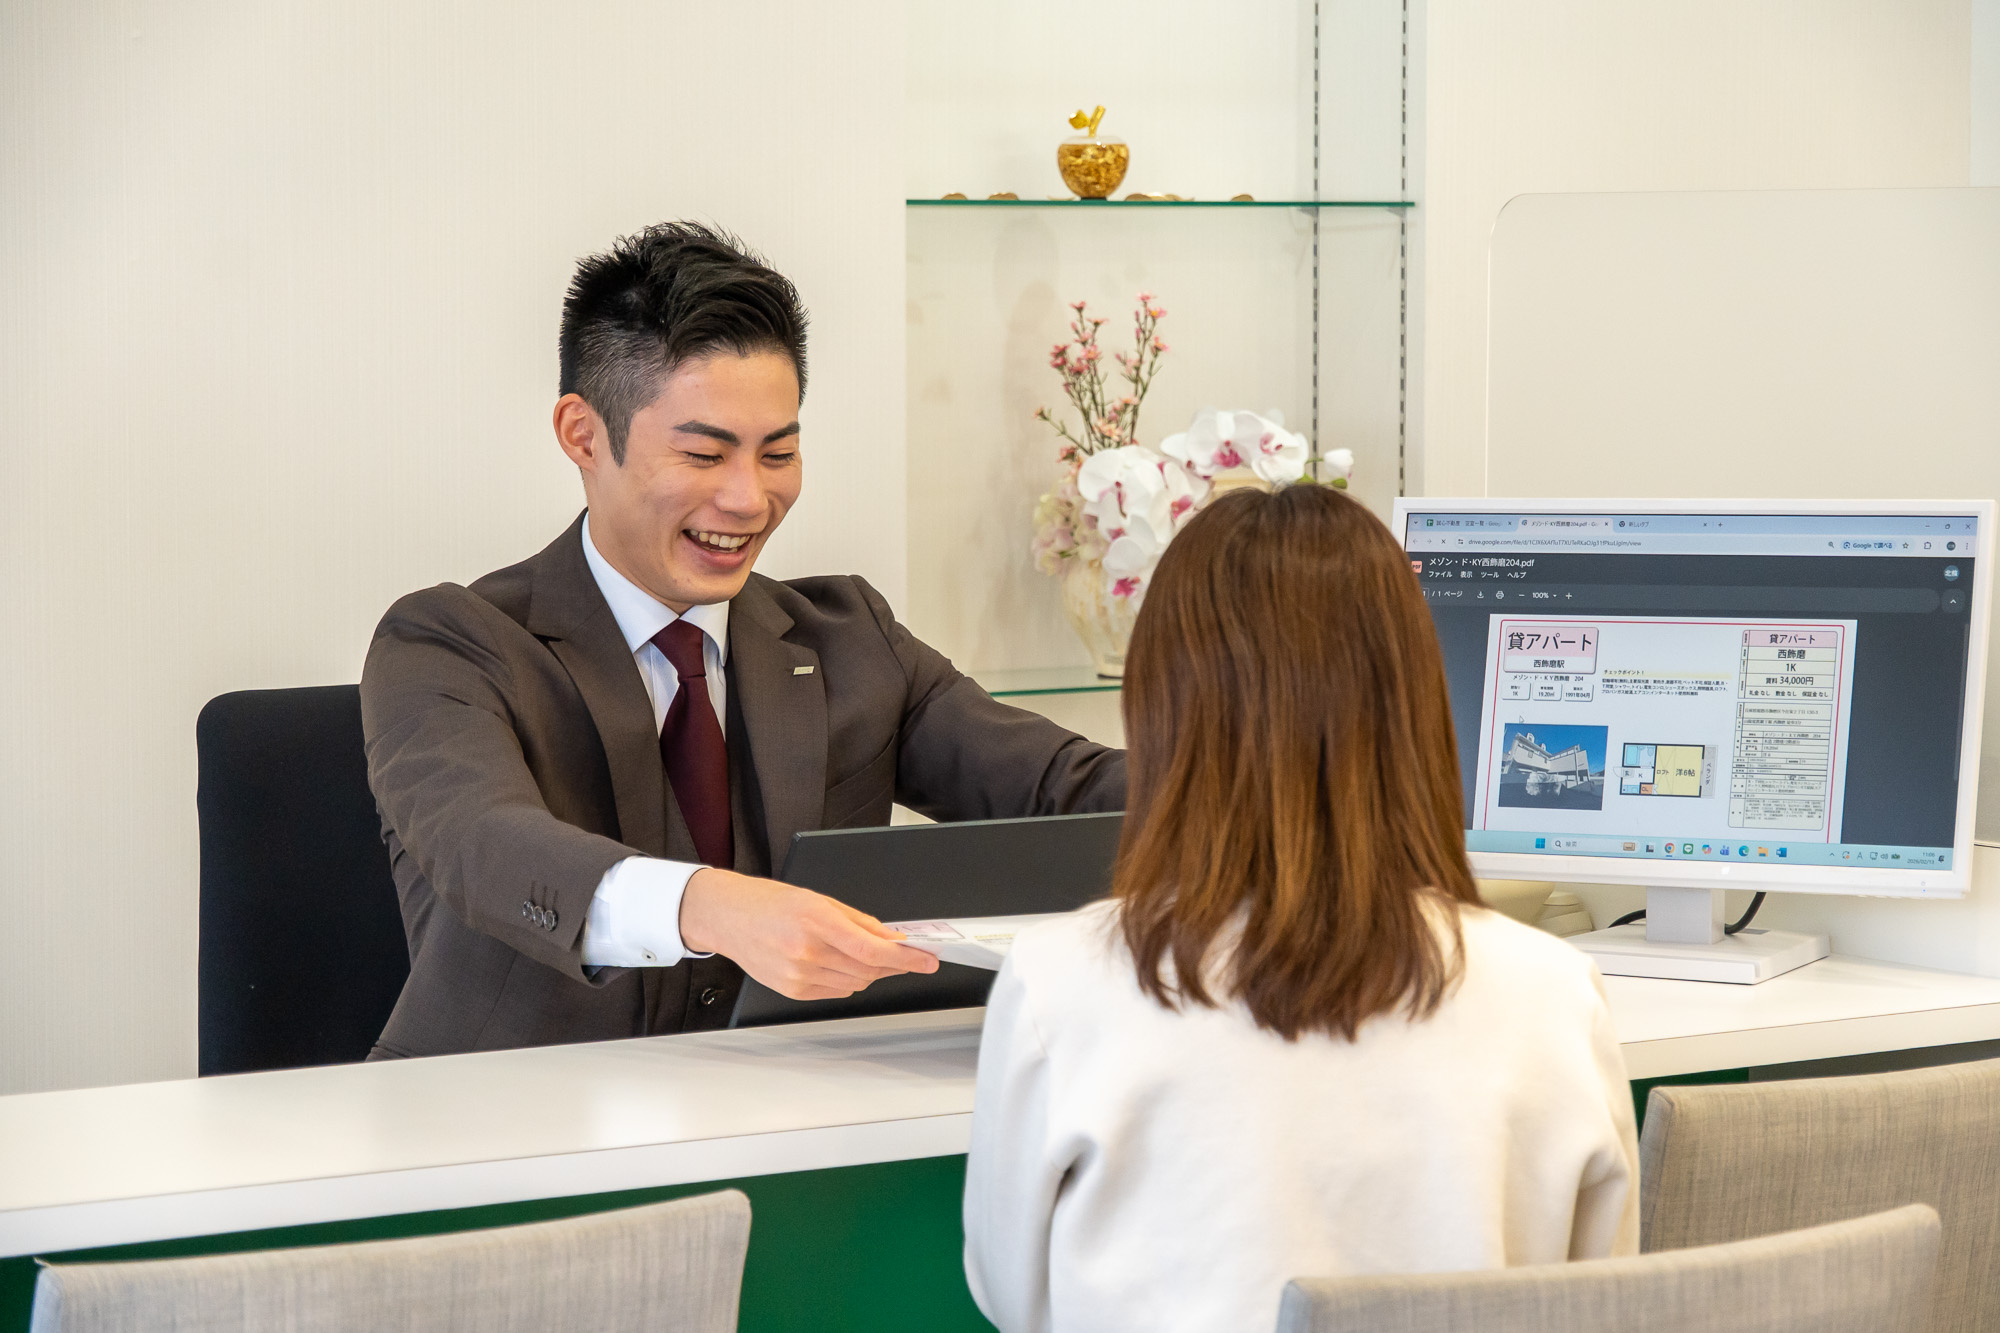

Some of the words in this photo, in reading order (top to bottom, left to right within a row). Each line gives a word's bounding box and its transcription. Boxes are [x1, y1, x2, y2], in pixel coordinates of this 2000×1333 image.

[1508, 632, 1593, 651] 貸アパート
[1769, 634, 1816, 644] 貸アパート
[1778, 649, 1806, 659] 西飾磨
[1533, 659, 1566, 668] 西飾磨駅
[1785, 663, 1797, 672] 1K
[1780, 677, 1814, 686] 34,000円
[1675, 769, 1696, 777] 洋6帖
